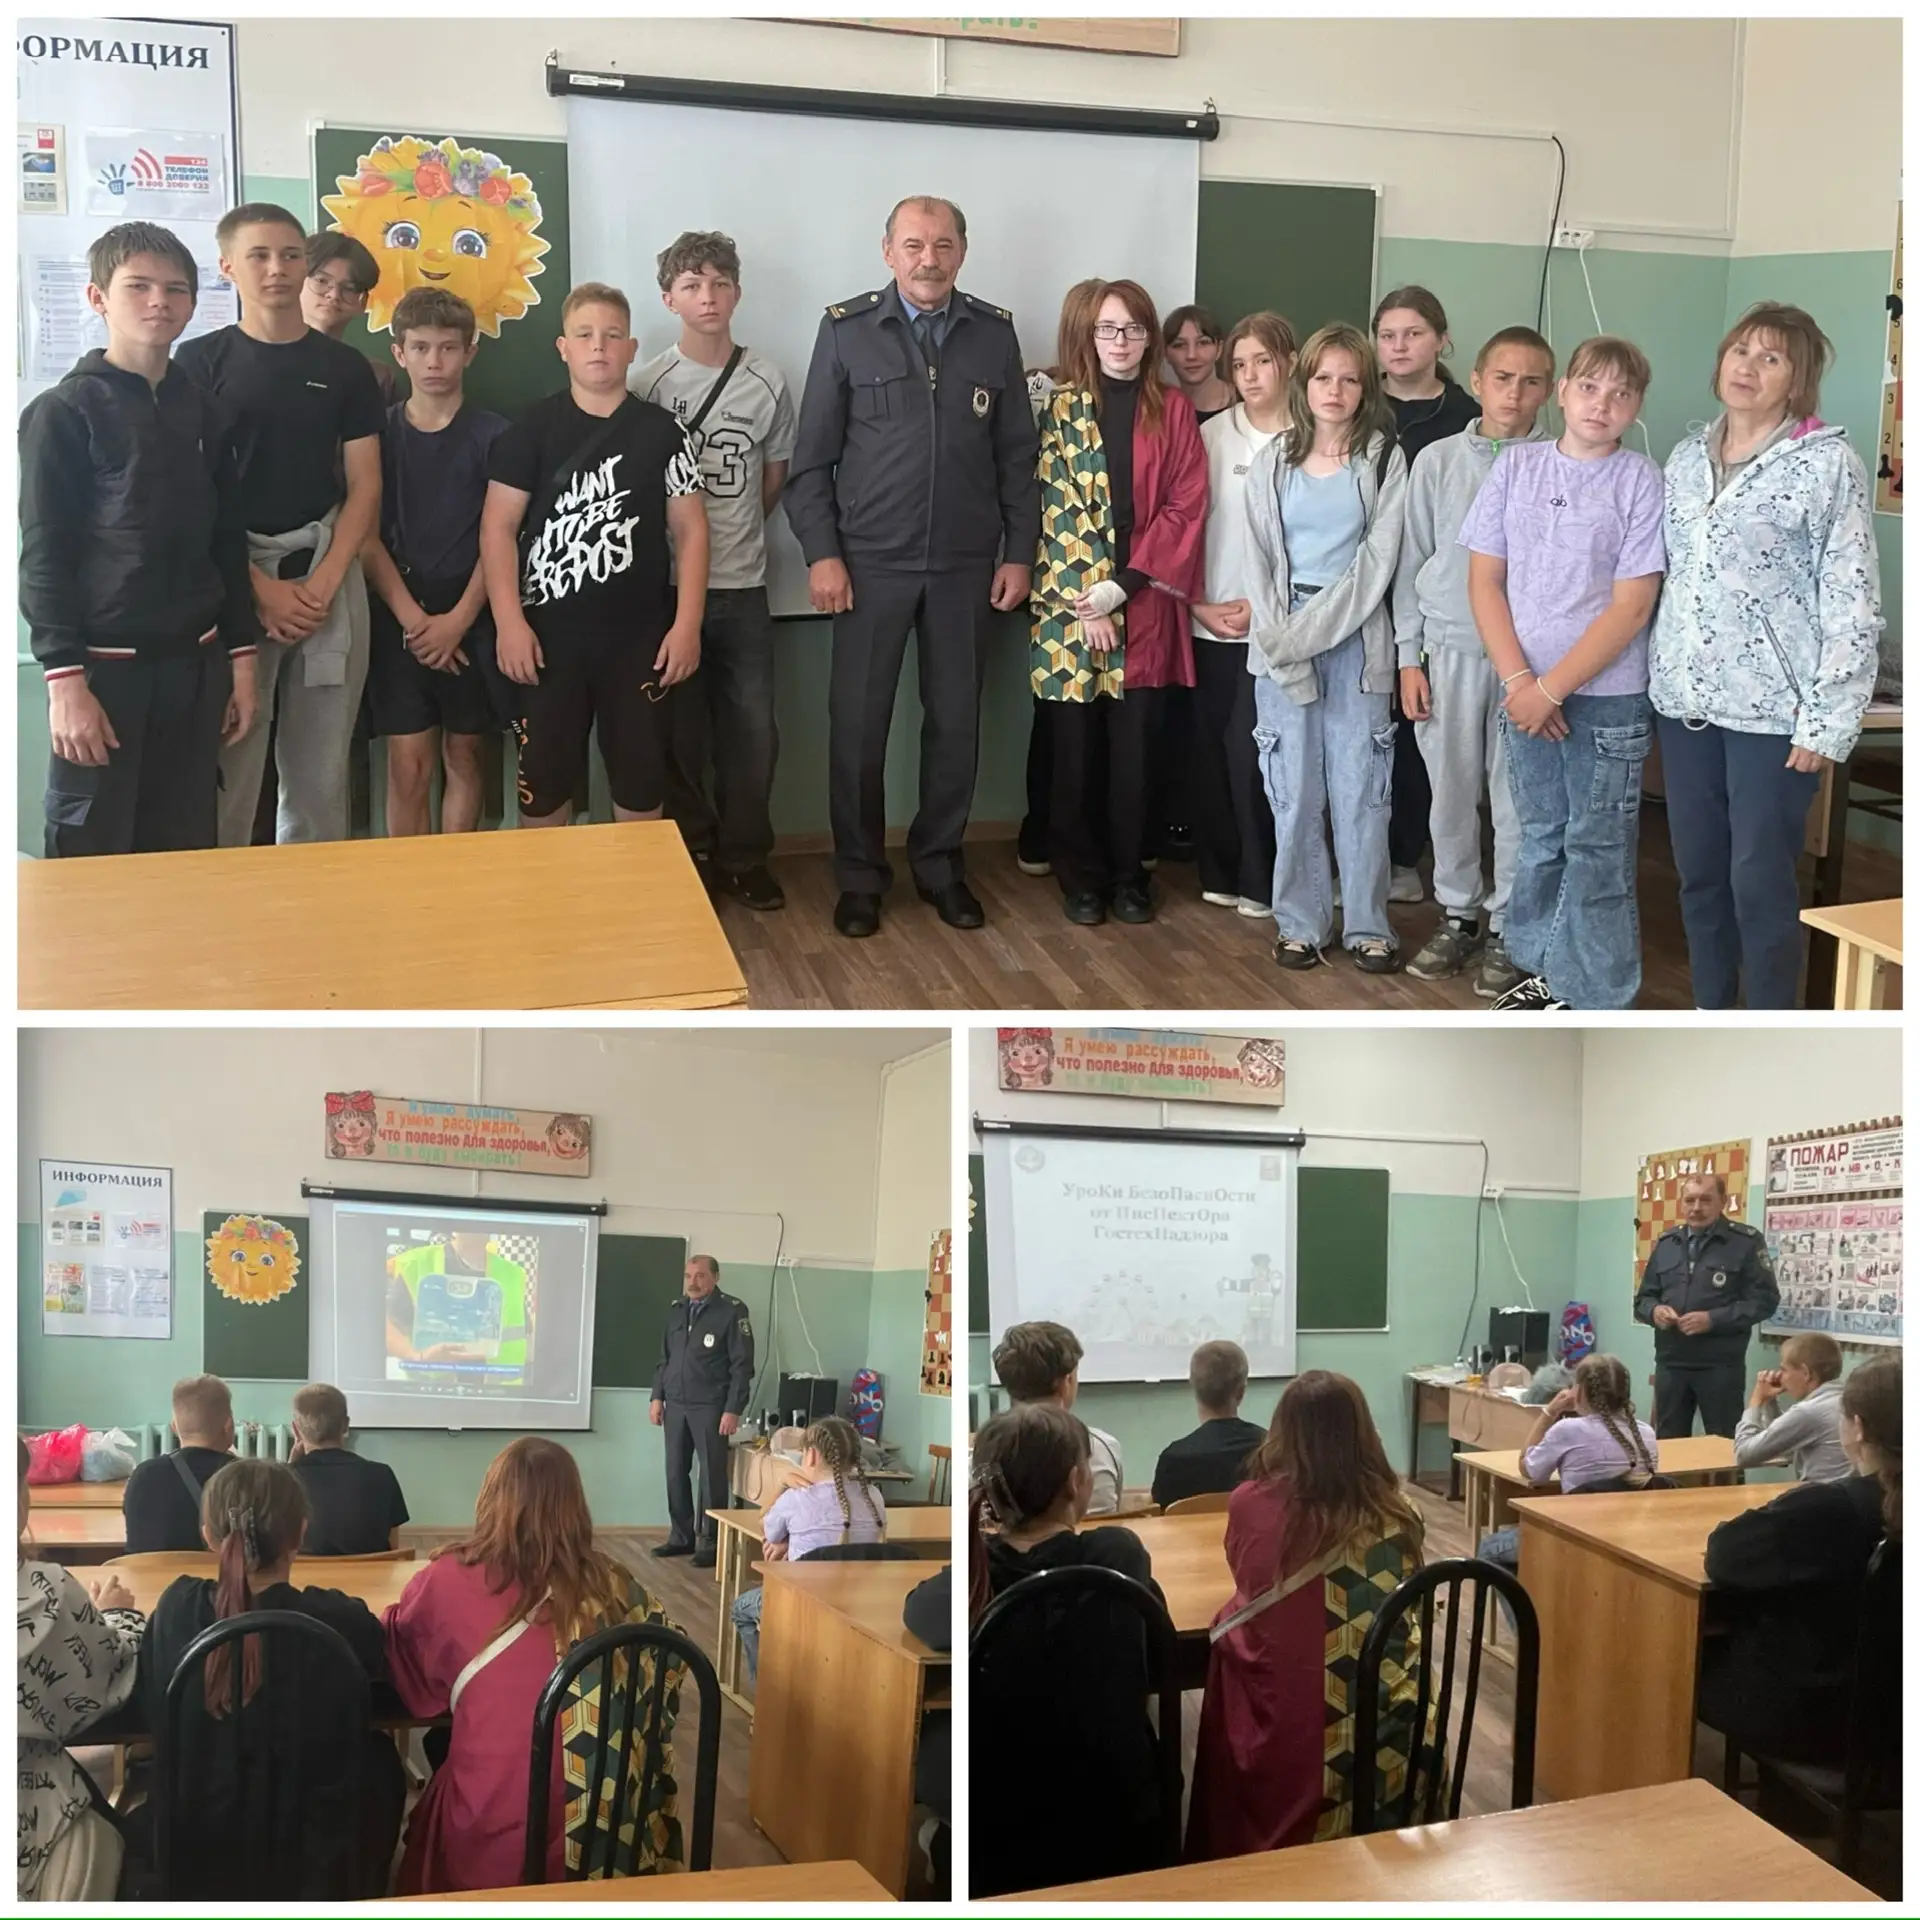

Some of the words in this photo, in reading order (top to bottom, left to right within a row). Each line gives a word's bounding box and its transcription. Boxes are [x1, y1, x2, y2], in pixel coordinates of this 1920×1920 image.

[17, 35, 210, 71] ОРМАЦИЯ
[1064, 1038, 1073, 1053] Я
[1079, 1040, 1117, 1056] умею
[1126, 1044, 1216, 1064] рассуждать,
[1056, 1056, 1081, 1070] что
[1086, 1057, 1145, 1074] полезно
[1178, 1064, 1244, 1085] здоровья,
[385, 1111, 394, 1125] Я
[400, 1115, 435, 1129] умею
[379, 1128, 400, 1142] что
[406, 1130, 459, 1147] полезно
[490, 1138, 550, 1157] здоровья,
[1790, 1142, 1849, 1167] ПОЖАР
[52, 1170, 163, 1187] ИНФОРМАЦИЯ
